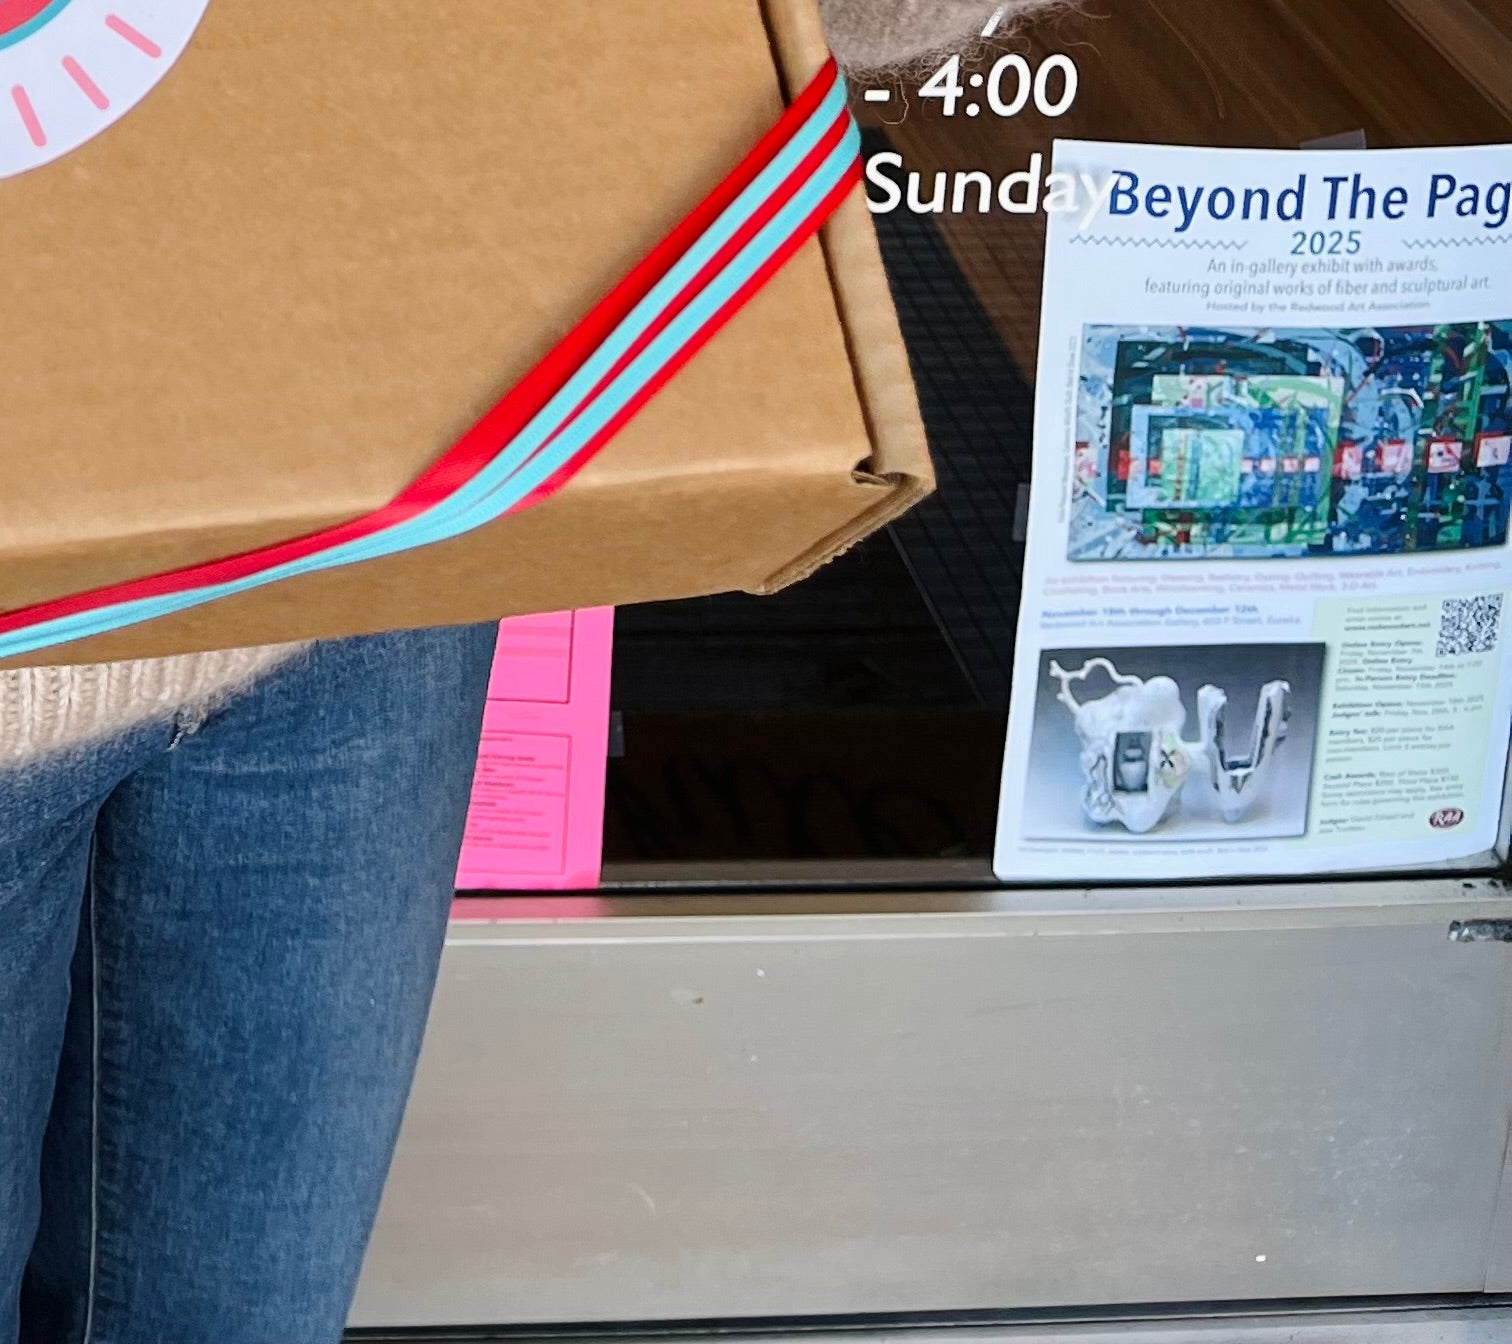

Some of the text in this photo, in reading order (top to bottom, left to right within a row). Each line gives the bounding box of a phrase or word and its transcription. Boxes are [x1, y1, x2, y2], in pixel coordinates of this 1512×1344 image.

[918, 53, 1079, 118] 4:00
[865, 152, 1120, 231] Sunday
[1109, 170, 1512, 232] Beyond The Pag
[1290, 231, 1361, 255] 2025
[1207, 259, 1227, 273] An
[1231, 258, 1298, 278] in-gallery
[1301, 258, 1350, 273] exhibit
[1353, 257, 1383, 272] with
[1144, 277, 1210, 298] featuring
[1214, 279, 1270, 299] original
[1273, 280, 1314, 295] works
[1317, 279, 1333, 295] of
[1335, 278, 1367, 294] fiber
[1370, 277, 1397, 294] and
[1400, 275, 1468, 297] sculptural
[1206, 301, 1248, 311] Hosted
[1251, 301, 1265, 313] by
[1268, 301, 1287, 311] the
